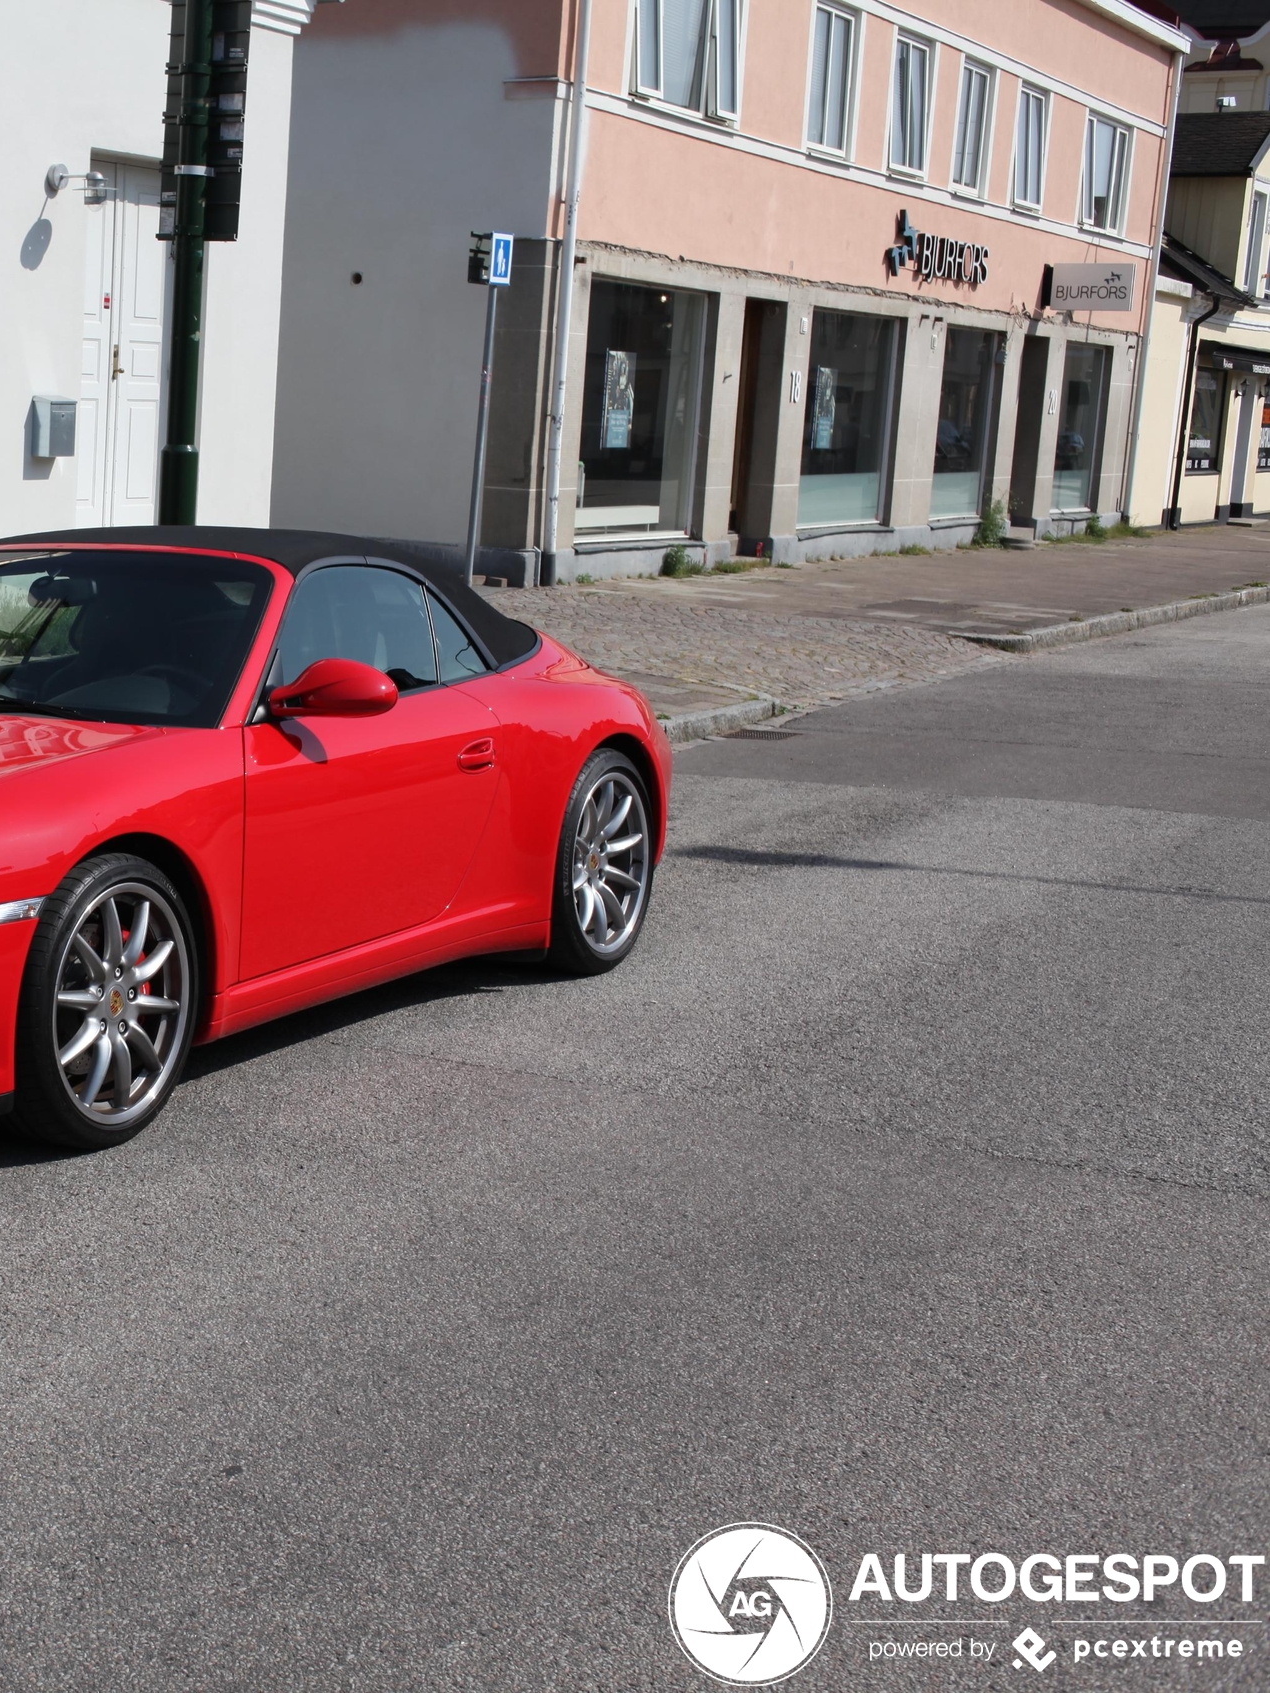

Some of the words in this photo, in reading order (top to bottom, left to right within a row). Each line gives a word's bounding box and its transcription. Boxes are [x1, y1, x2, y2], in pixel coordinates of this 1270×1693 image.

[922, 233, 990, 284] BJURFORS
[1055, 285, 1127, 300] BJURFORS
[791, 370, 801, 402] 18
[1049, 389, 1058, 414] 20
